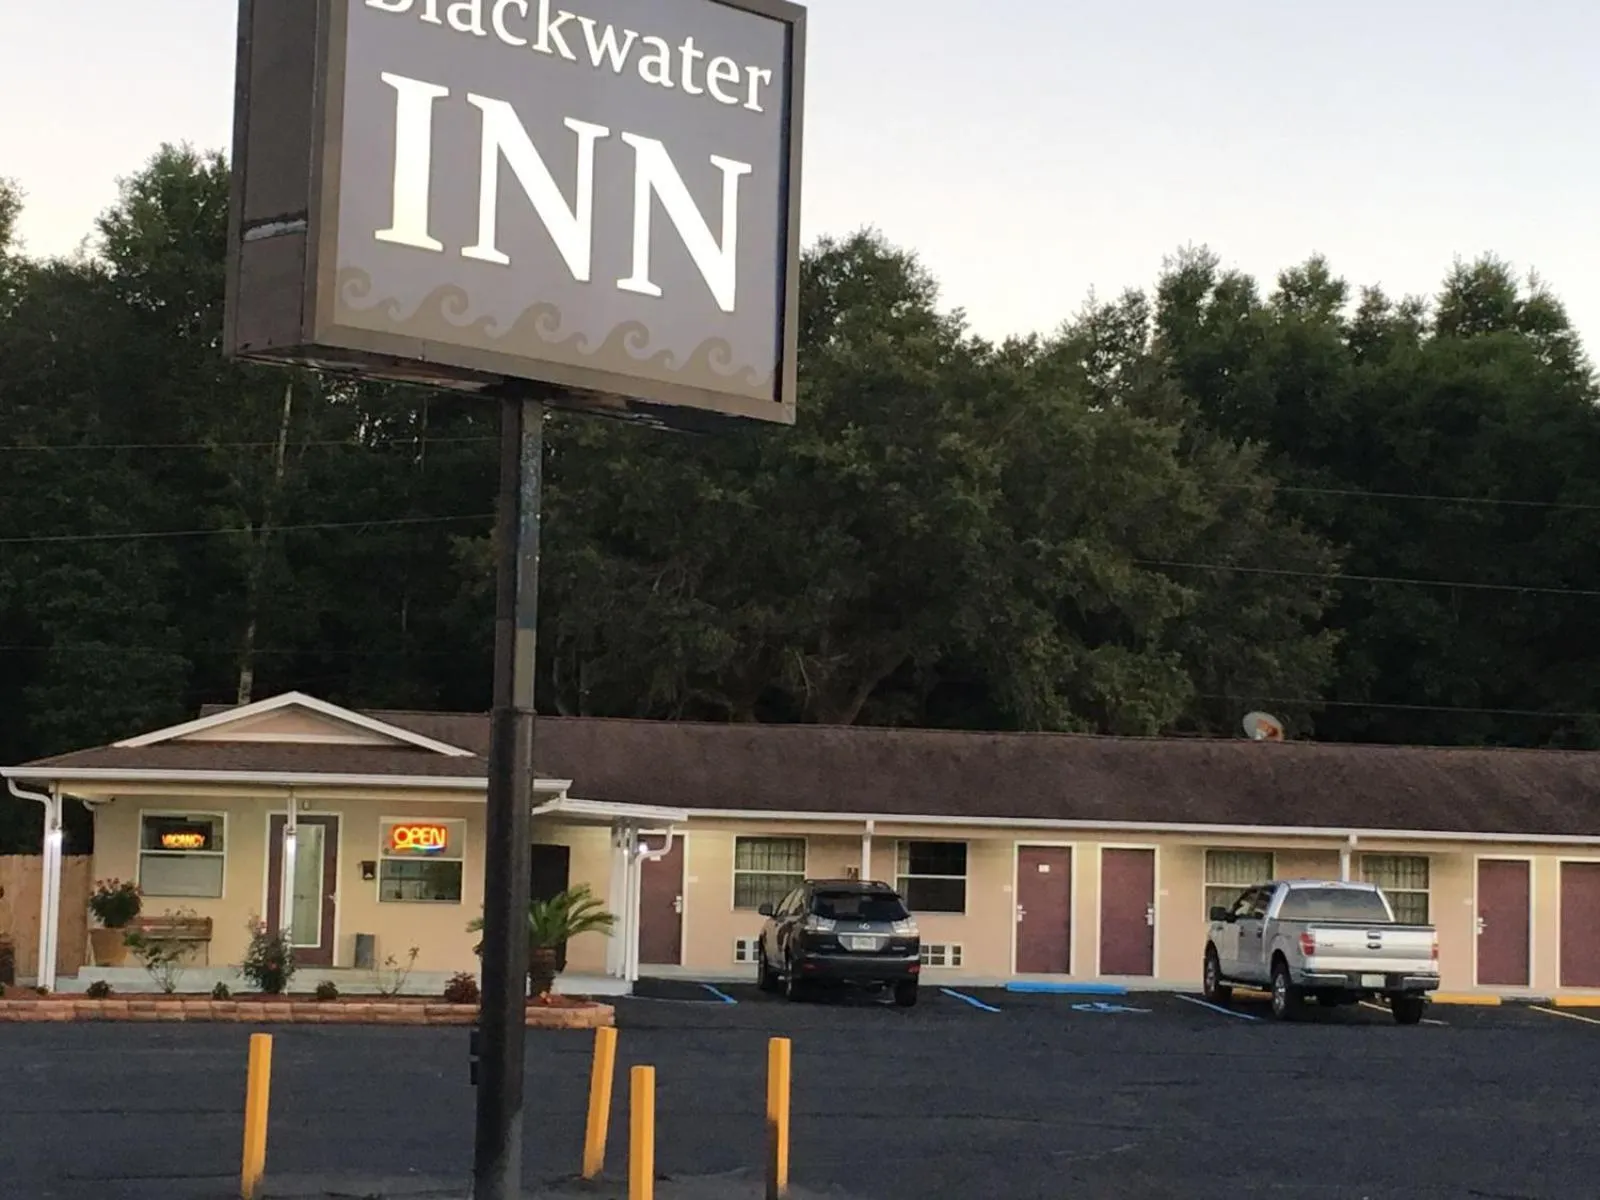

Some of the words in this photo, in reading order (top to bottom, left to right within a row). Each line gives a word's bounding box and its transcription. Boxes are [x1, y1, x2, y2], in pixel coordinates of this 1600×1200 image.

[364, 0, 772, 112] ackwater
[375, 71, 752, 313] INN
[394, 826, 446, 847] OPEN
